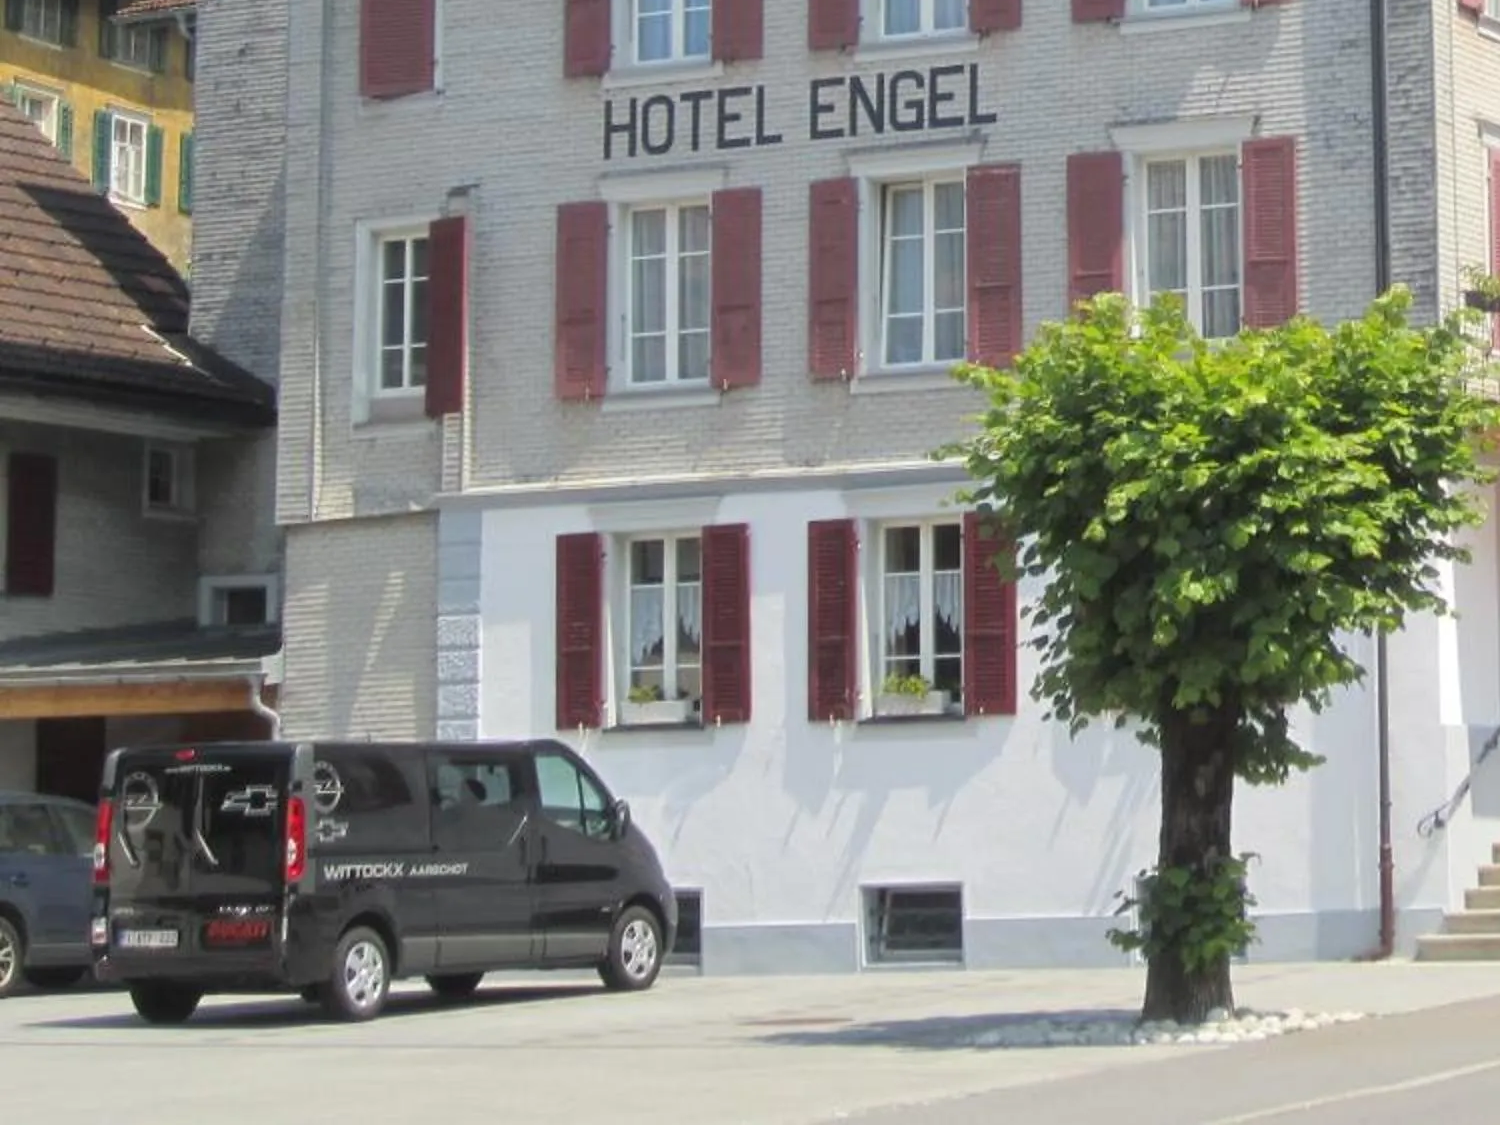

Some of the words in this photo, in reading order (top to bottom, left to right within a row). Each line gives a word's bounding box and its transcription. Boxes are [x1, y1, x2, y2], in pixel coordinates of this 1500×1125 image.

[602, 84, 783, 160] HOTEL
[809, 62, 998, 141] ENGEL
[323, 863, 405, 881] WITTOCKX
[409, 863, 470, 876] AARSCHOT
